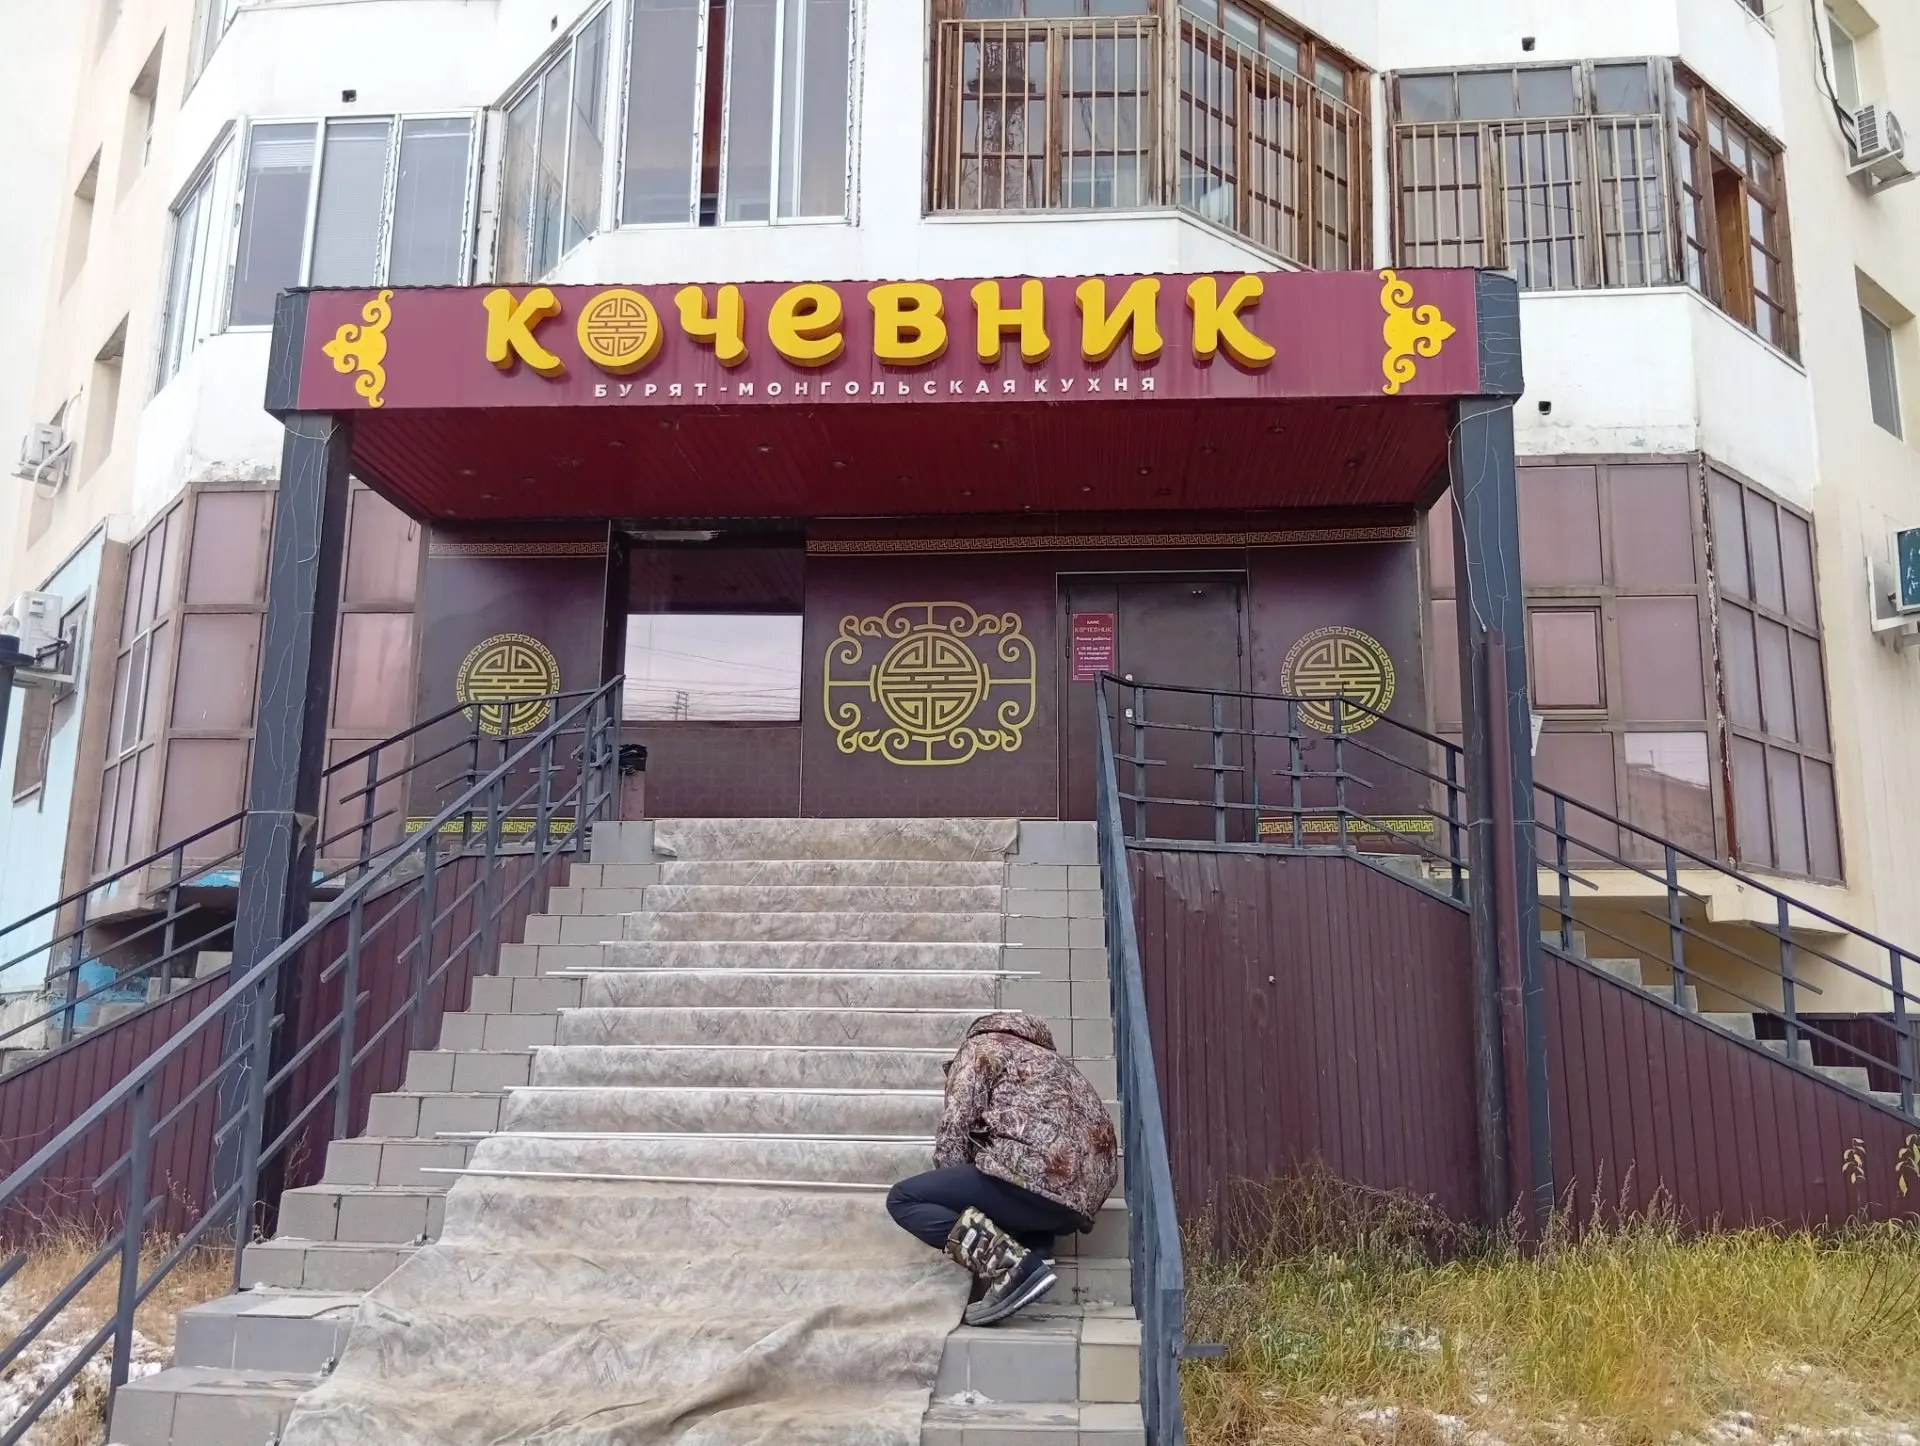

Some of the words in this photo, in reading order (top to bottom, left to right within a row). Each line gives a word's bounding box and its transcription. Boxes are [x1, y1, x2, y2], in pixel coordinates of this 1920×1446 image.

[482, 274, 1276, 378] КОЧЕВНИК
[593, 379, 1017, 398] БУРЯТ-МОНГОЛЬСКАЯ
[1033, 376, 1156, 394] КУХНЯ
